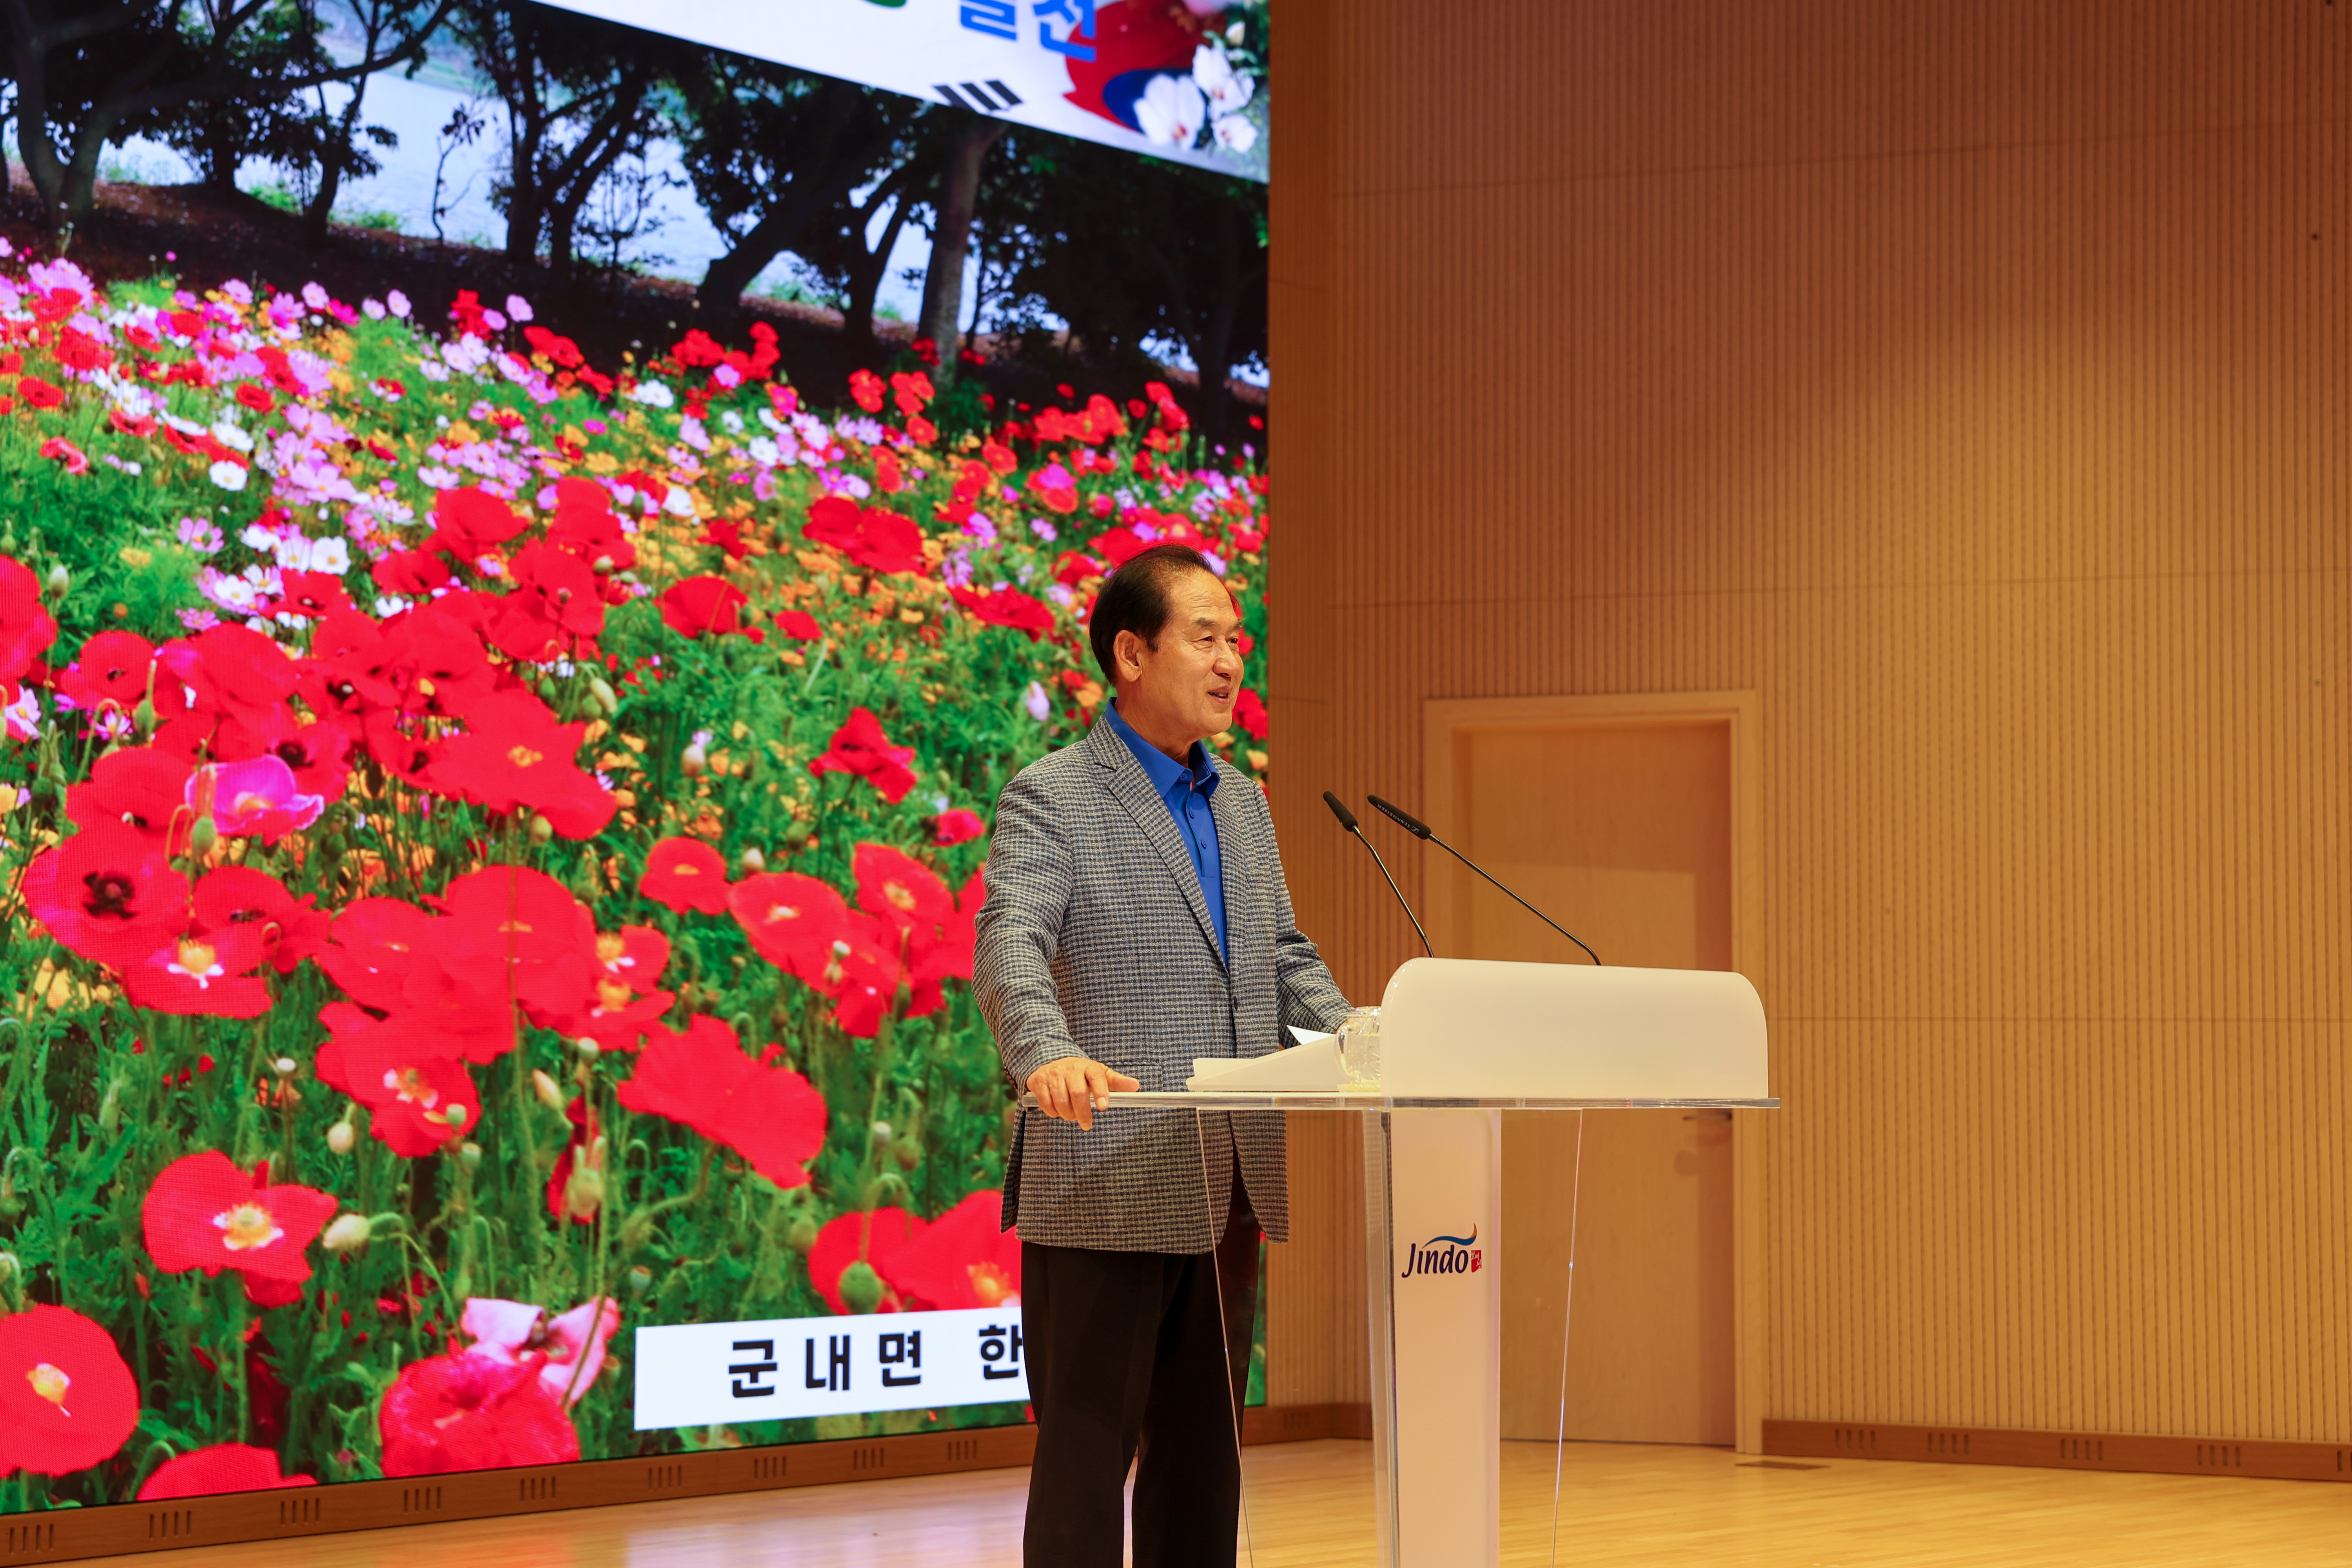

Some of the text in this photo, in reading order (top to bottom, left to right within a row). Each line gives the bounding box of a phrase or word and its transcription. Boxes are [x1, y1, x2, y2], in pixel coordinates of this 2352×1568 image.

[1377, 804, 1411, 828] SENNHEISER
[1401, 1243, 1468, 1278] Jindo
[729, 1330, 921, 1398] 군내면
